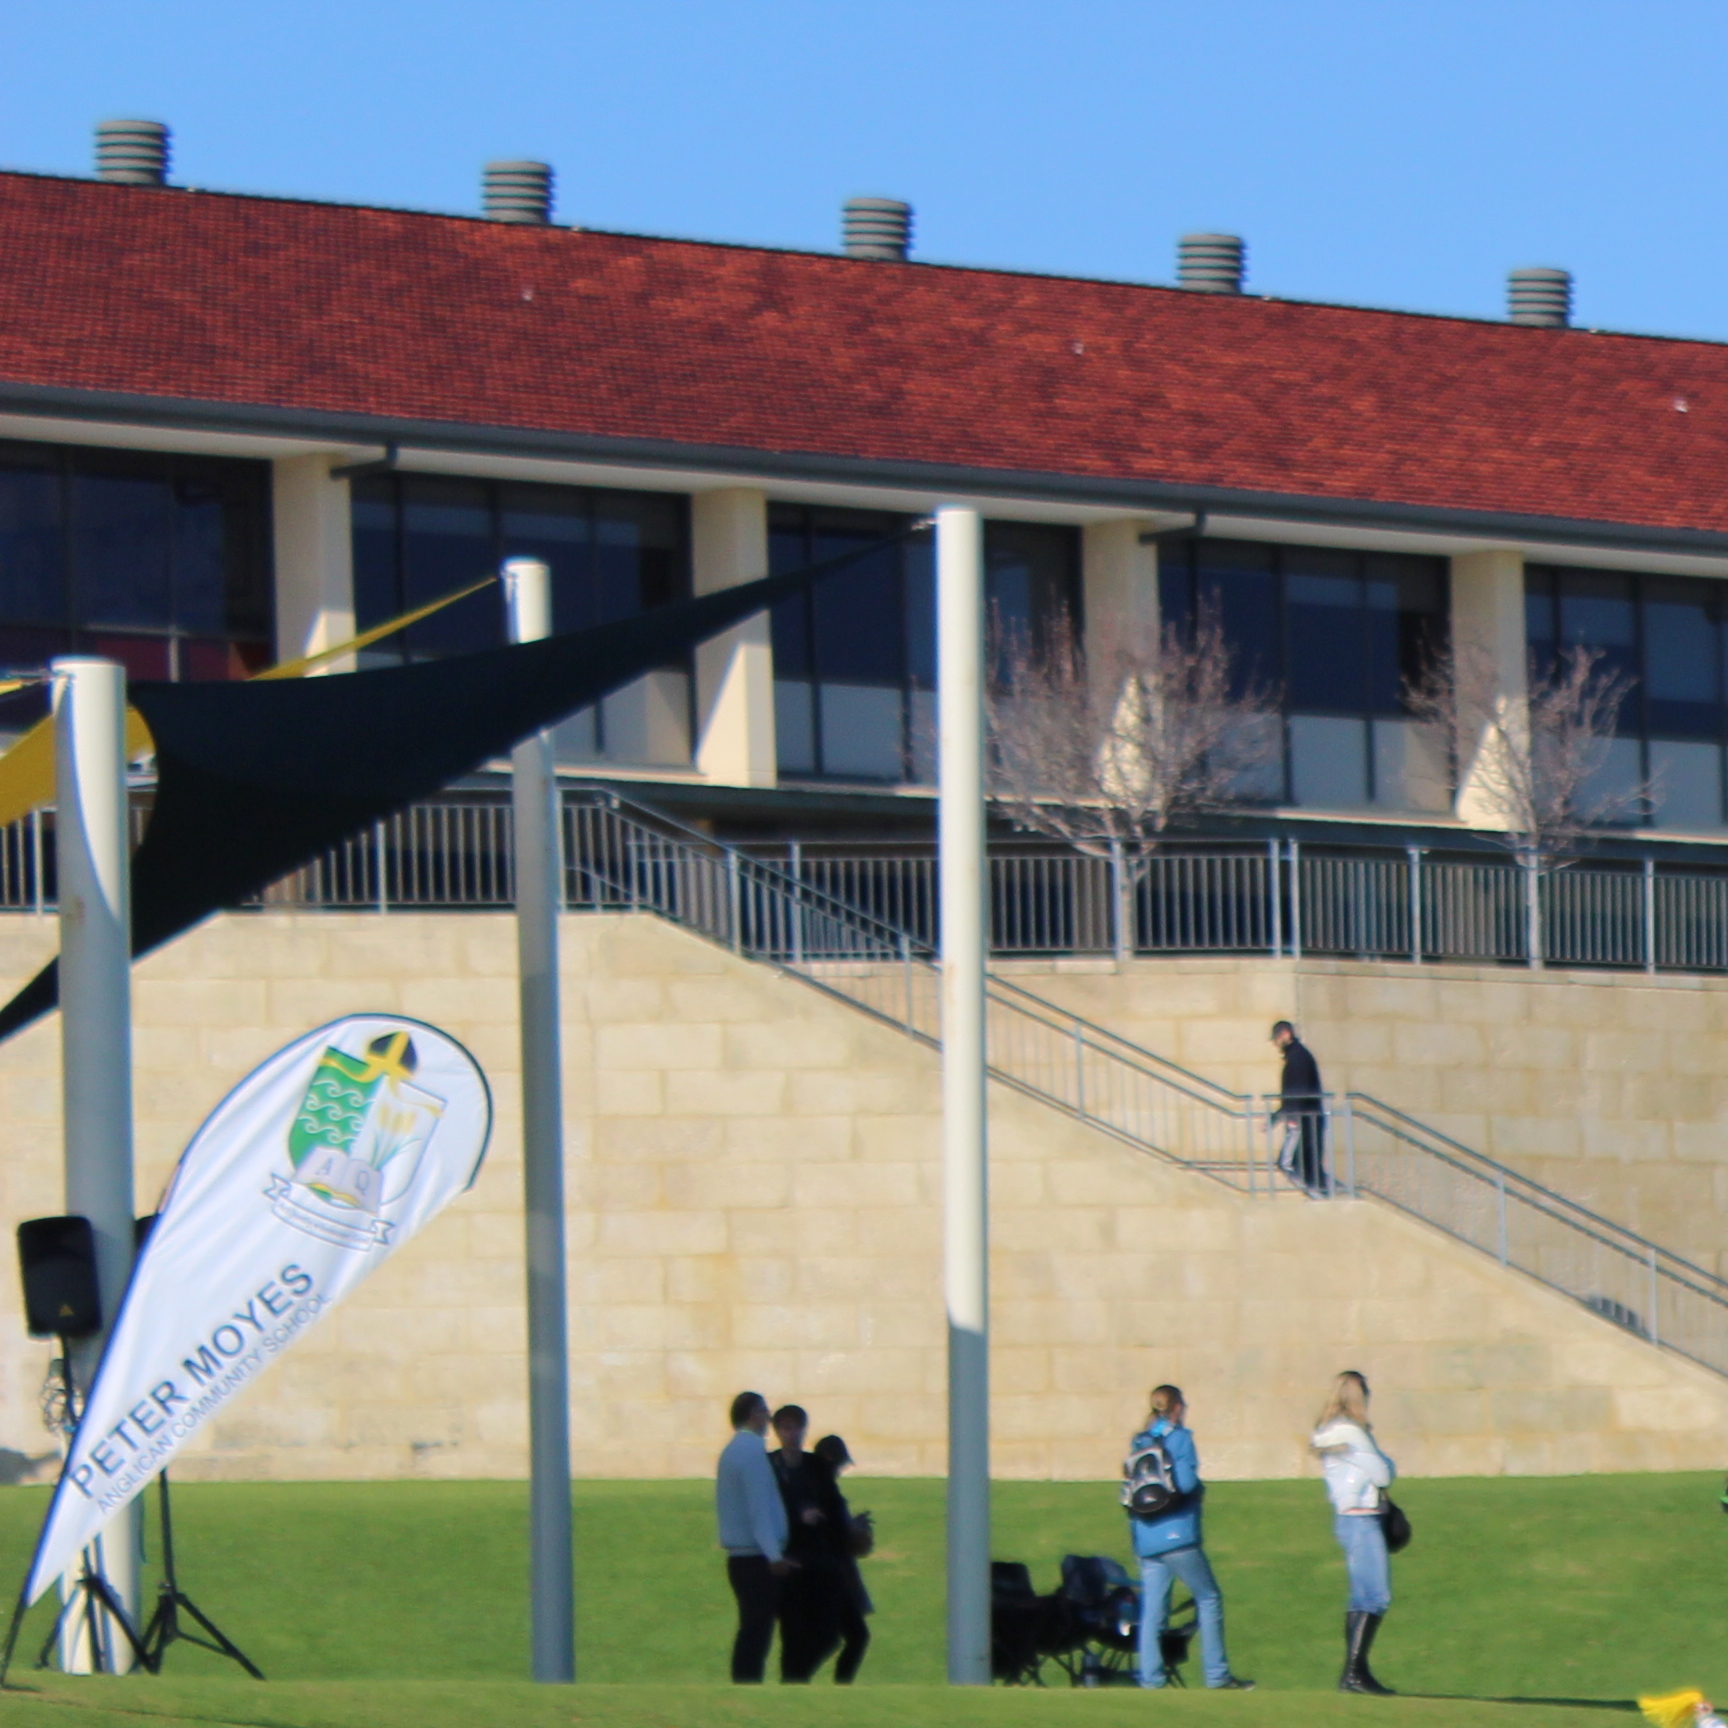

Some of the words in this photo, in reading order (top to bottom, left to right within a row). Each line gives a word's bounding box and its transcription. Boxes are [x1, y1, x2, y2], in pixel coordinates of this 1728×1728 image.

[68, 1380, 189, 1498] PETER
[182, 1263, 314, 1387] MOYES
[97, 1434, 174, 1514] ANGLICAN
[171, 1347, 263, 1438] COMMUNITY
[261, 1292, 329, 1353] SCHOOL
